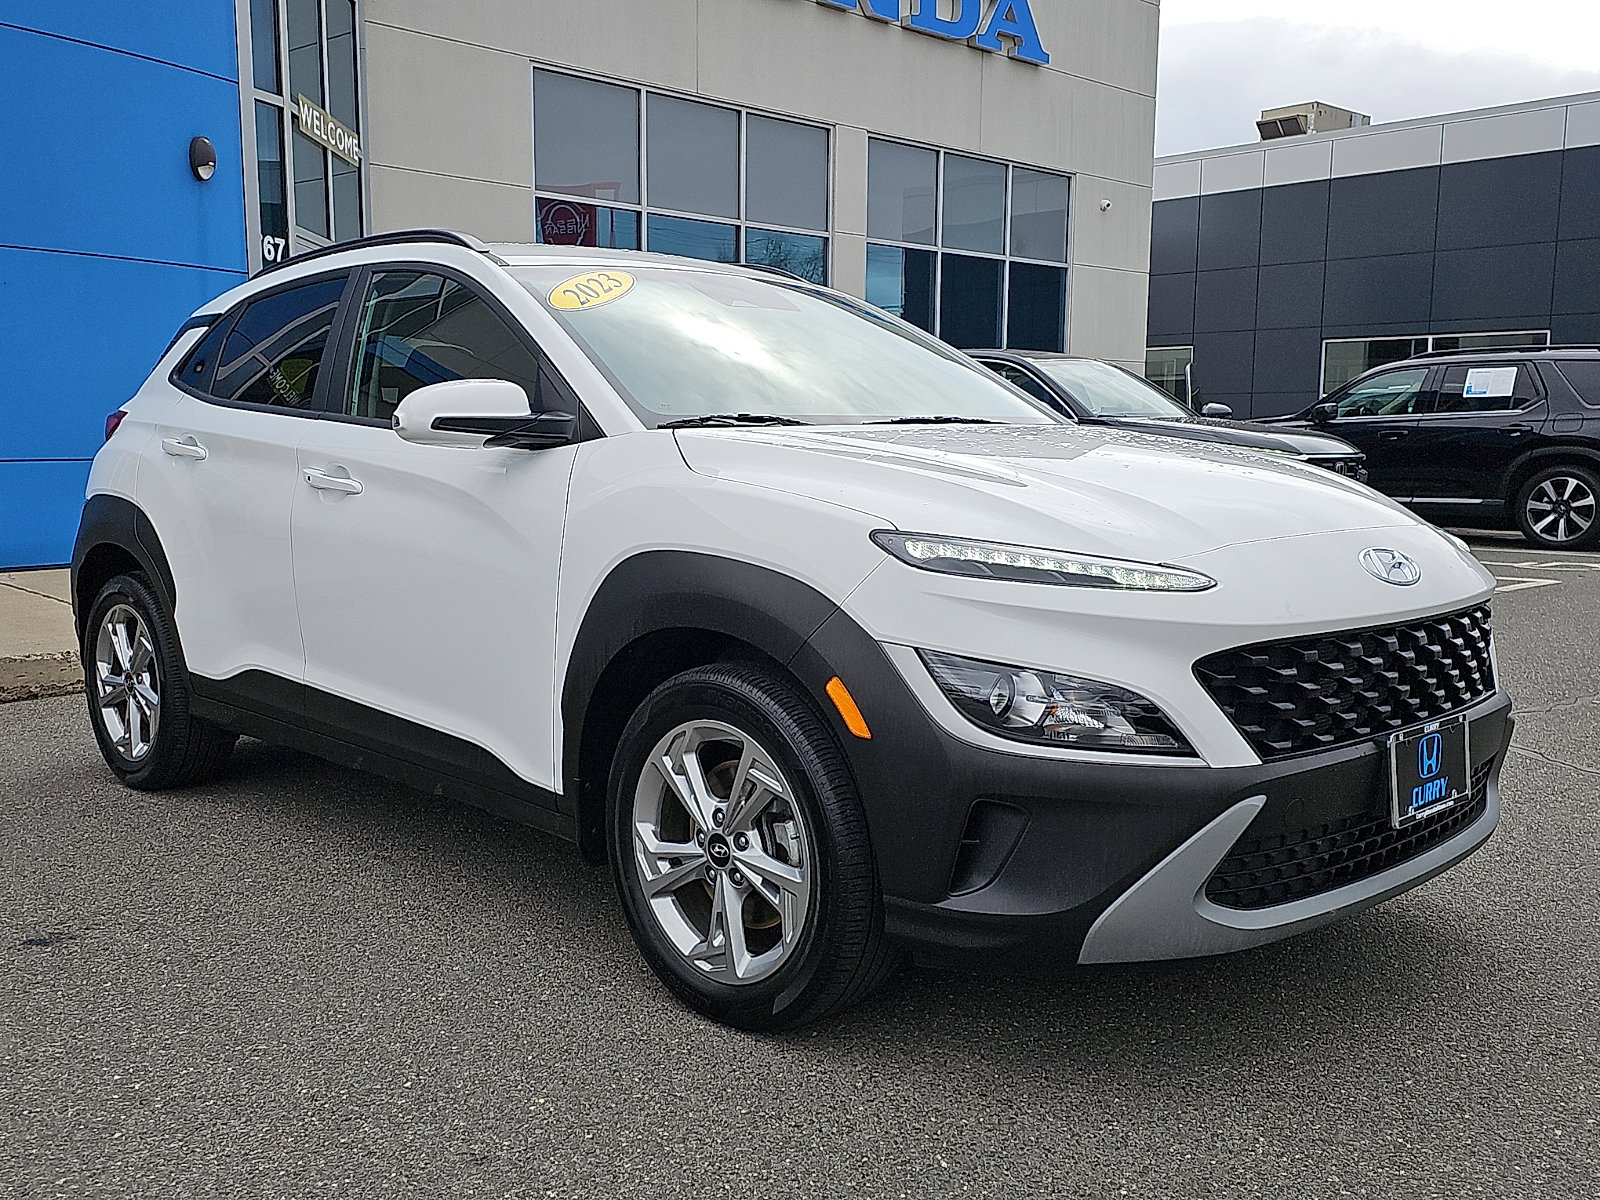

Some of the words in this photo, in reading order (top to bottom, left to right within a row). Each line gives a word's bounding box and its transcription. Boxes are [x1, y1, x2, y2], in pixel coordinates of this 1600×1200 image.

[300, 100, 359, 162] WELCOME
[263, 235, 286, 263] 67
[562, 273, 623, 306] 2023
[1412, 776, 1449, 808] CURRY
